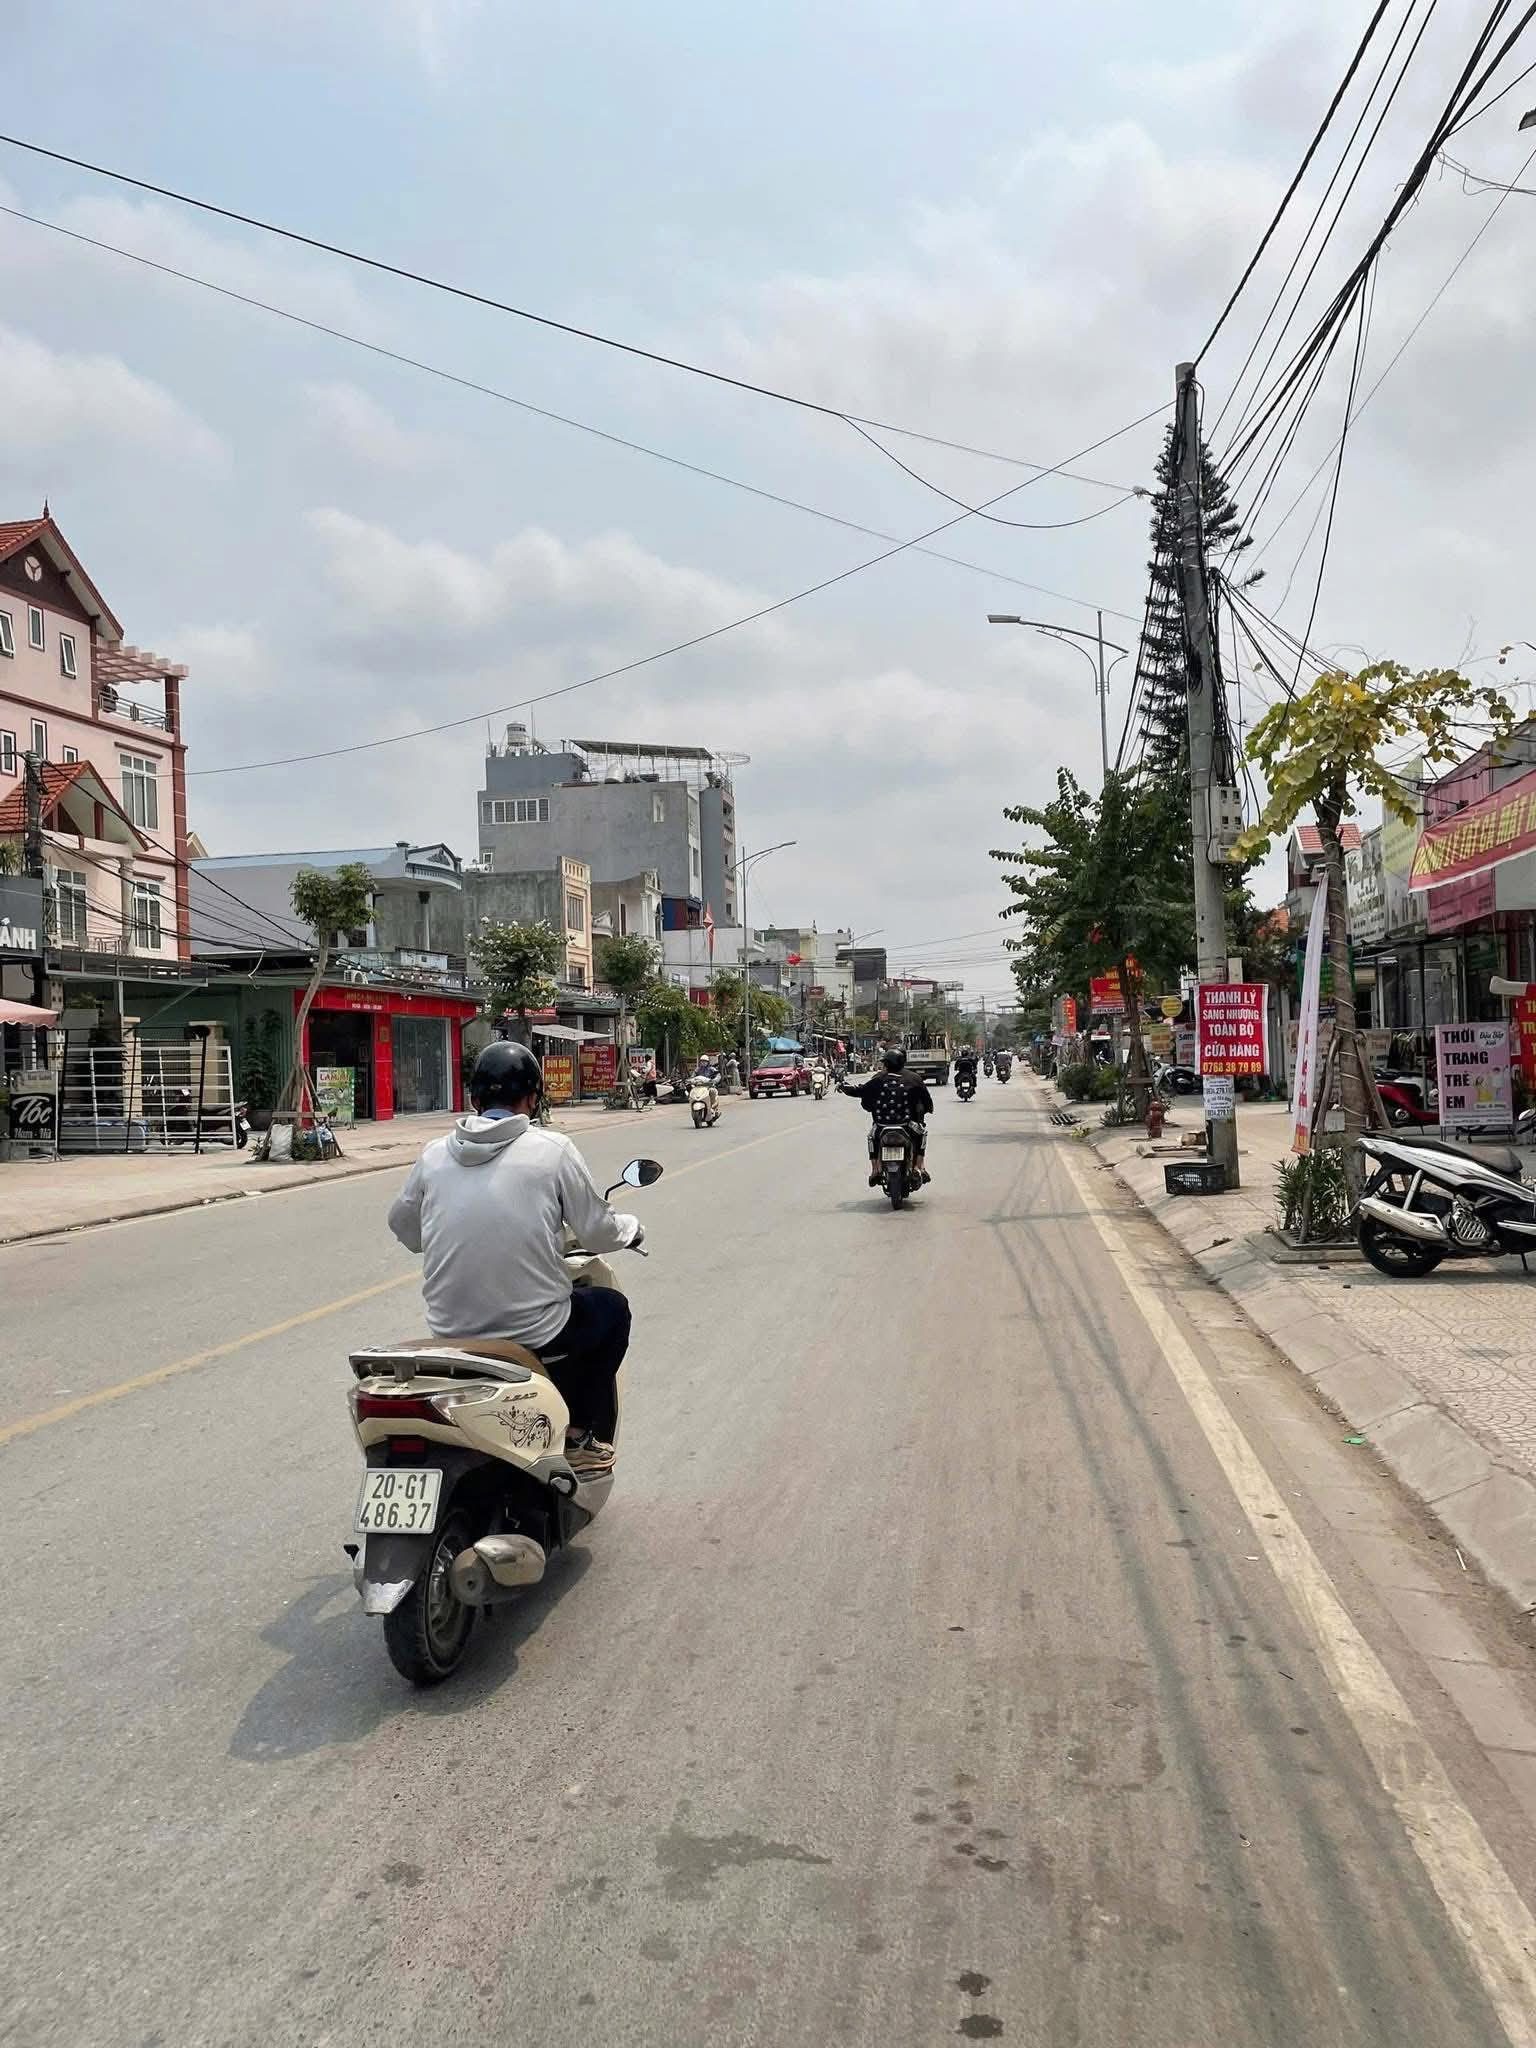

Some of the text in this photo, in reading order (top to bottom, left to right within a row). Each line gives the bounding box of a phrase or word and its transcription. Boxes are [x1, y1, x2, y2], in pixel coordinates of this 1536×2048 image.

[1205, 989, 1256, 1004] THANH LÝ
[1203, 1008, 1259, 1022] SANG NHƯỢNG
[1209, 1021, 1254, 1038] TOÀN BỘ
[1229, 1041, 1259, 1057] HÀNG
[1444, 1051, 1489, 1065] TRANG
[11, 1095, 52, 1124] Tóc
[1446, 1095, 1465, 1109] EM
[372, 1473, 427, 1499] 20-G1
[360, 1501, 432, 1529] 486.37
